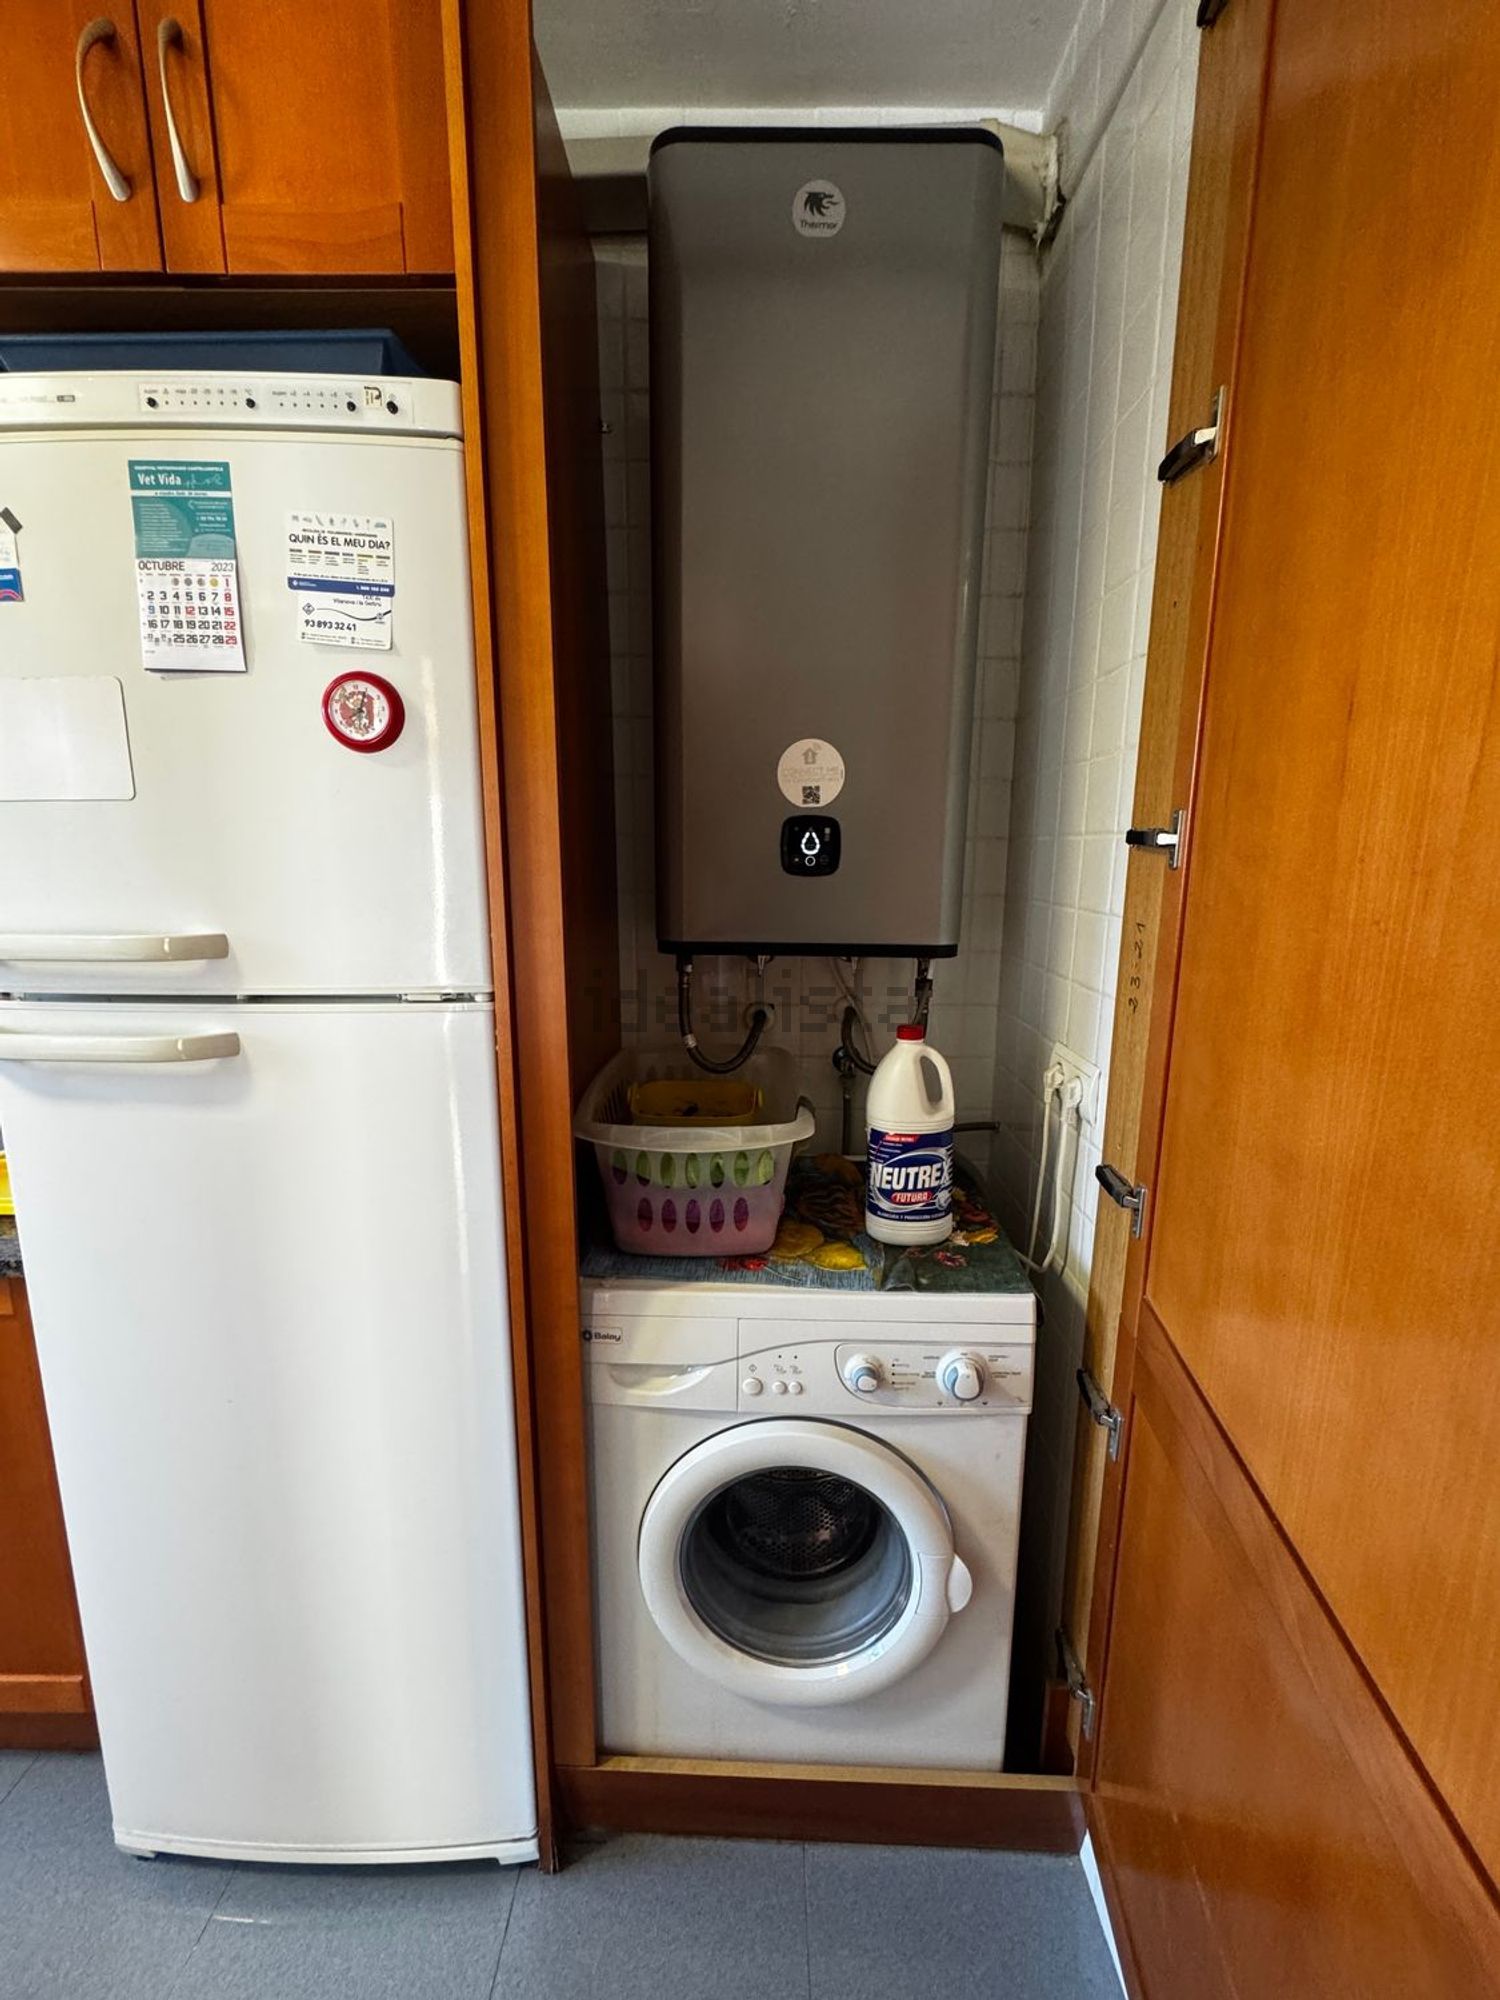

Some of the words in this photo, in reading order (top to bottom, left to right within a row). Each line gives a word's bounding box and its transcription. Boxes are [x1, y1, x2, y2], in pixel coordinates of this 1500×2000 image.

[800, 220, 838, 230] Thermor
[138, 473, 156, 486] Vet
[158, 474, 182, 486] Vida
[289, 534, 315, 544] QUIN
[317, 534, 328, 545] ÉS
[331, 536, 341, 546] EL
[344, 538, 366, 548] MEU
[368, 540, 391, 550] DIA?
[138, 561, 185, 571] OCTUBRE
[211, 562, 234, 572] 2023
[147, 591, 154, 600] 2
[160, 591, 167, 600] 3
[173, 592, 180, 601] 4
[186, 592, 193, 601] 5
[198, 592, 206, 601] 6
[212, 592, 219, 601] 7
[224, 593, 232, 602] 8
[148, 606, 155, 614] 9
[160, 606, 169, 615] 10
[174, 606, 181, 615] 11
[185, 606, 196, 615] 12
[198, 607, 208, 616] 13
[211, 607, 221, 616] 14
[224, 607, 235, 616] 15
[148, 620, 158, 629] 16
[160, 620, 170, 629] 17
[173, 620, 183, 629] 18
[186, 621, 196, 629] 19
[198, 621, 210, 630] 20
[212, 622, 222, 630] 21
[224, 622, 236, 631] 22
[304, 619, 315, 627] 93
[316, 620, 333, 630] 893
[334, 621, 345, 630] 32
[346, 623, 357, 632] 41
[173, 634, 185, 643] 25
[186, 635, 198, 644] 26
[199, 635, 210, 644] 27
[212, 636, 224, 645] 28
[225, 636, 237, 645] 29
[870, 1160, 951, 1190] NEUTREX
[895, 1192, 929, 1203] FUTURA
[594, 1332, 621, 1342] Balay
